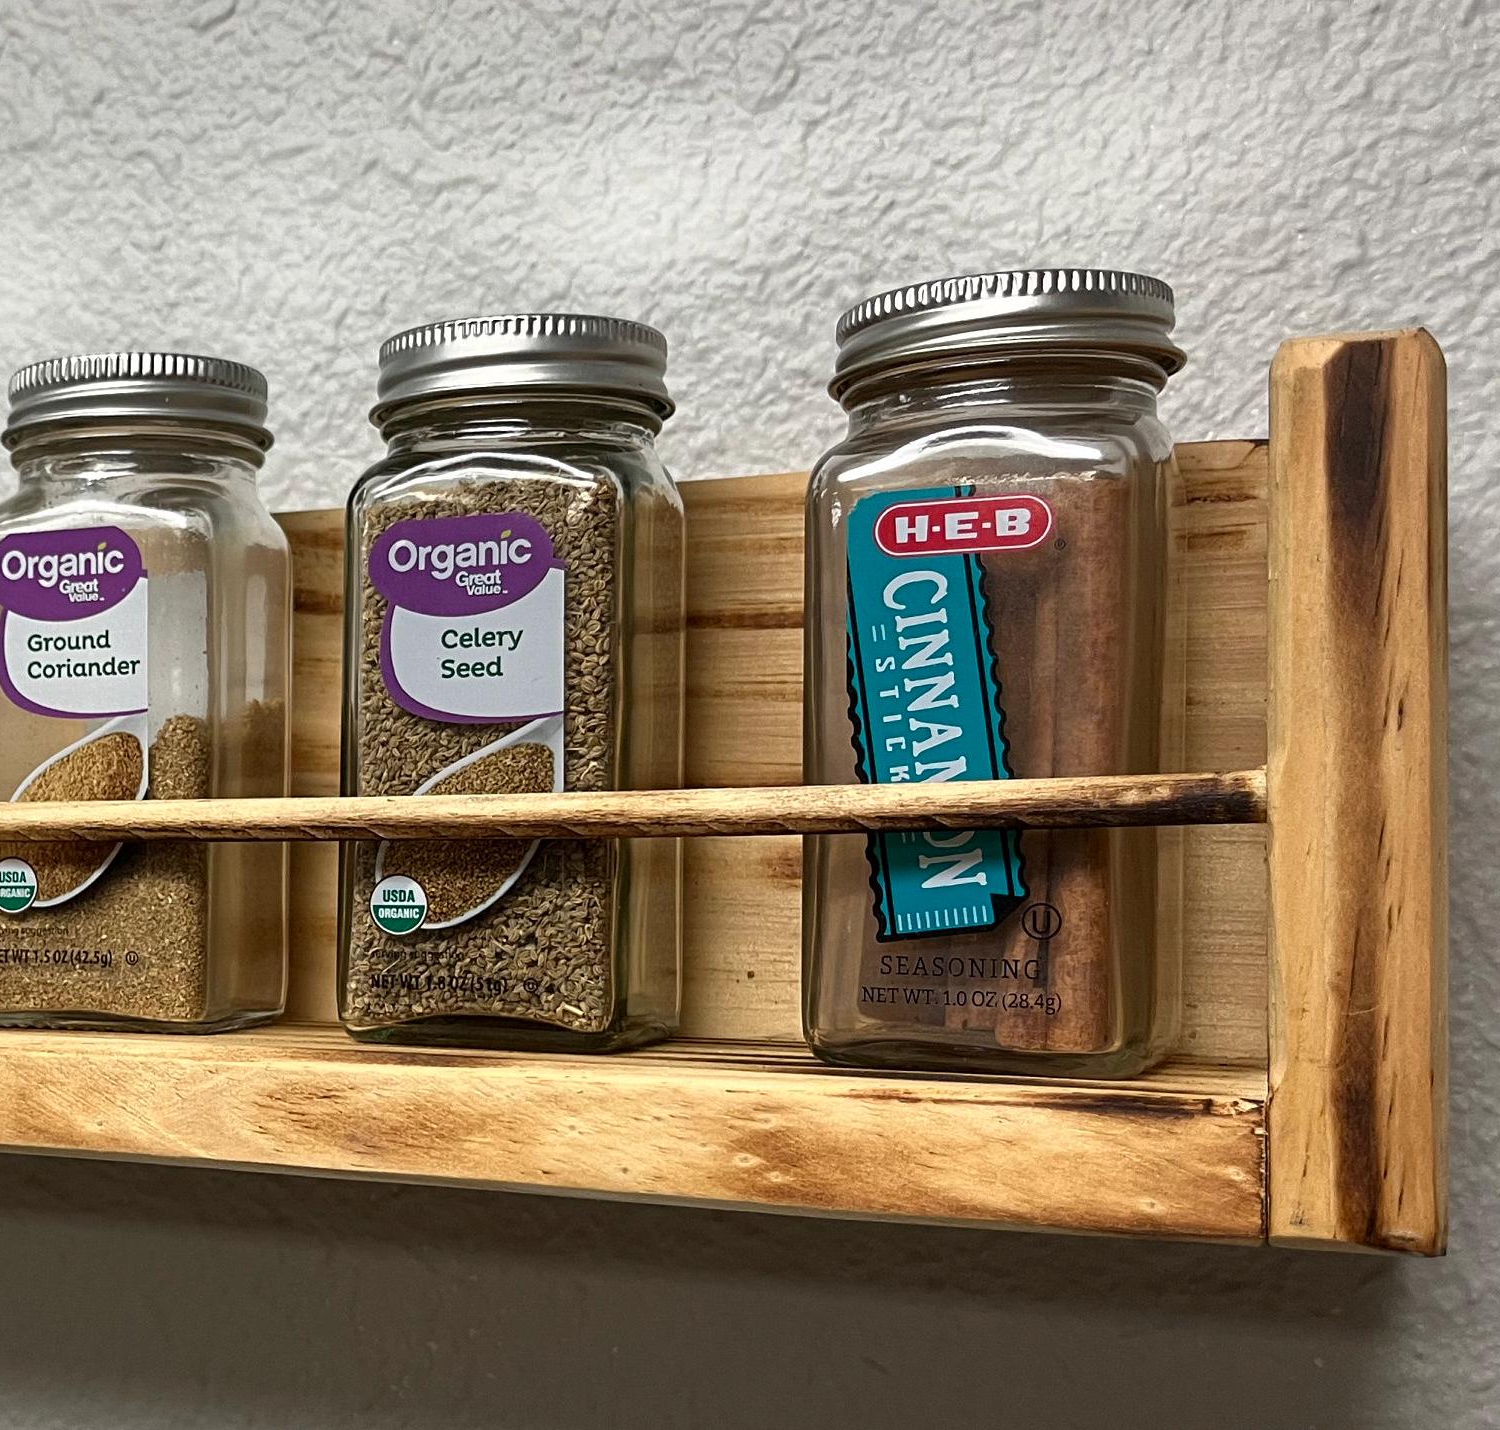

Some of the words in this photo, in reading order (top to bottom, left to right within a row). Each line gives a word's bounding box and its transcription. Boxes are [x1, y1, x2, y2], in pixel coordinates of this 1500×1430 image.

[1, 542, 124, 588] Organic
[388, 529, 532, 580] Organic
[59, 578, 99, 595] Great
[455, 569, 501, 587] Great
[69, 592, 99, 602] Value
[467, 584, 501, 596] Value
[27, 629, 111, 652] Ground
[441, 627, 524, 651] Celery
[27, 656, 141, 679] Coriander
[441, 656, 504, 679] Seed
[382, 889, 415, 903] USDA
[378, 907, 420, 919] ORGANIC
[12, 949, 30, 963] WT
[32, 949, 50, 963] 1.5
[52, 949, 68, 963] OZ
[70, 949, 112, 968] (42.5g)
[880, 955, 1039, 980] SEASONING
[370, 974, 396, 989] NET
[862, 986, 898, 1004] NET
[903, 988, 938, 1005] WT.
[943, 990, 966, 1006] 1.0
[1002, 992, 1062, 1016] (28.4g)
